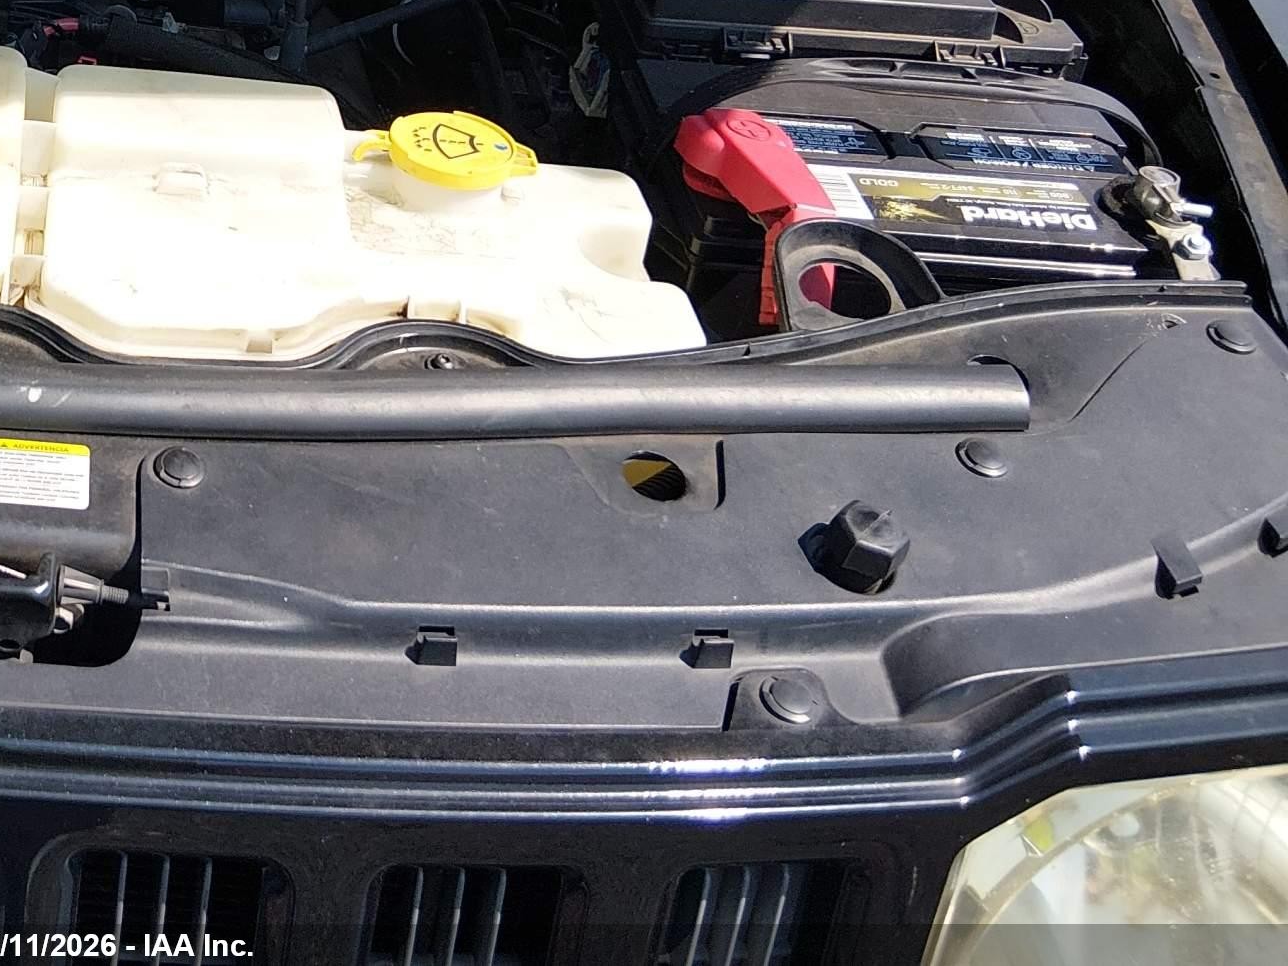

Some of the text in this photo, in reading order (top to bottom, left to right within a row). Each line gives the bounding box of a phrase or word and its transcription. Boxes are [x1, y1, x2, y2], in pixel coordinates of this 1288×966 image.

[858, 177, 899, 188] GOLD
[961, 205, 1098, 231] DieHard
[13, 443, 69, 452] ADVERTENCIA
